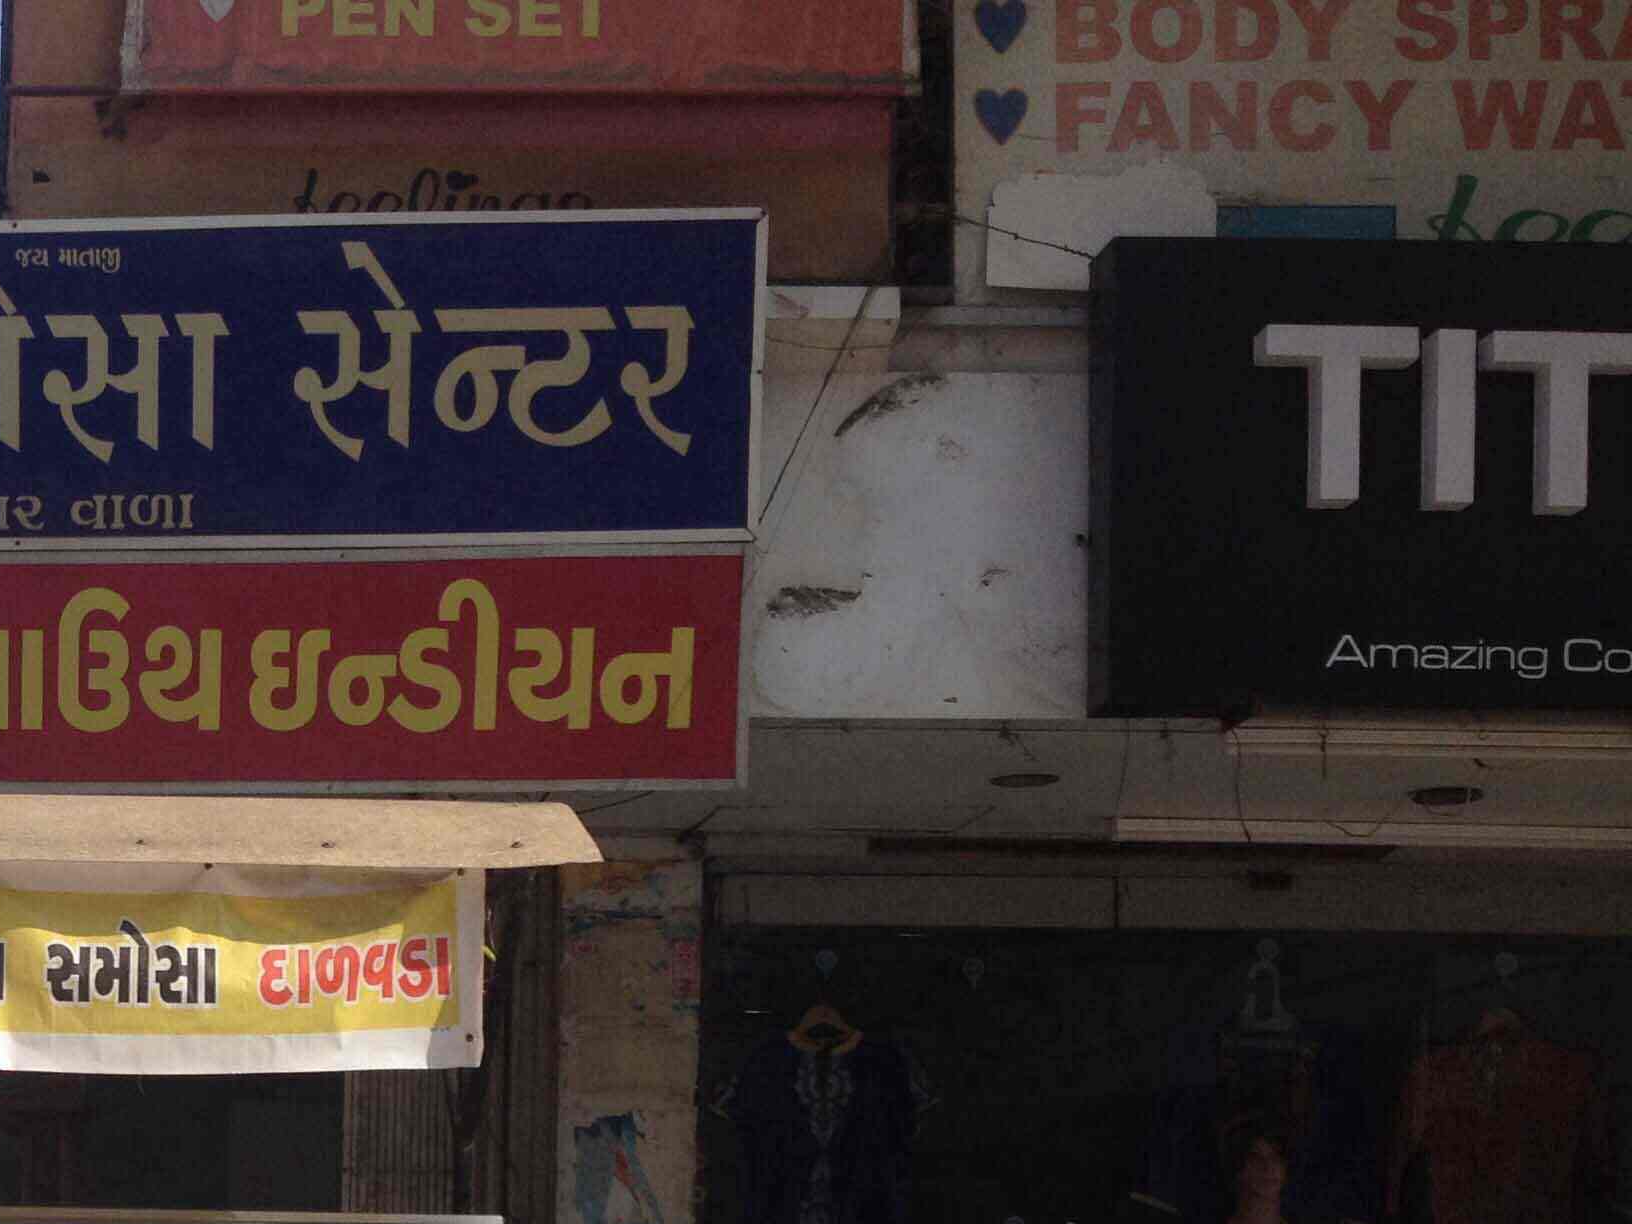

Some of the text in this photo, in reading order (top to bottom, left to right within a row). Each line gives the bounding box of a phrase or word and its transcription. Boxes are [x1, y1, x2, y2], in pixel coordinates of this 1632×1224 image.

[280, 0, 436, 37] PEN
[1056, 0, 1632, 64] BODY SPR
[1055, 79, 1632, 153] FANCY WA
[15, 247, 121, 274] જય માતાજી
[293, 240, 695, 462] સેન્ટર
[1254, 324, 1632, 516] TIT
[70, 493, 195, 529] વાળા
[248, 577, 696, 733] ઇન્ડીયન
[1324, 632, 1632, 680] Amazing Co
[46, 919, 217, 1004] સમોસા
[259, 936, 451, 1007] દાળવડા
